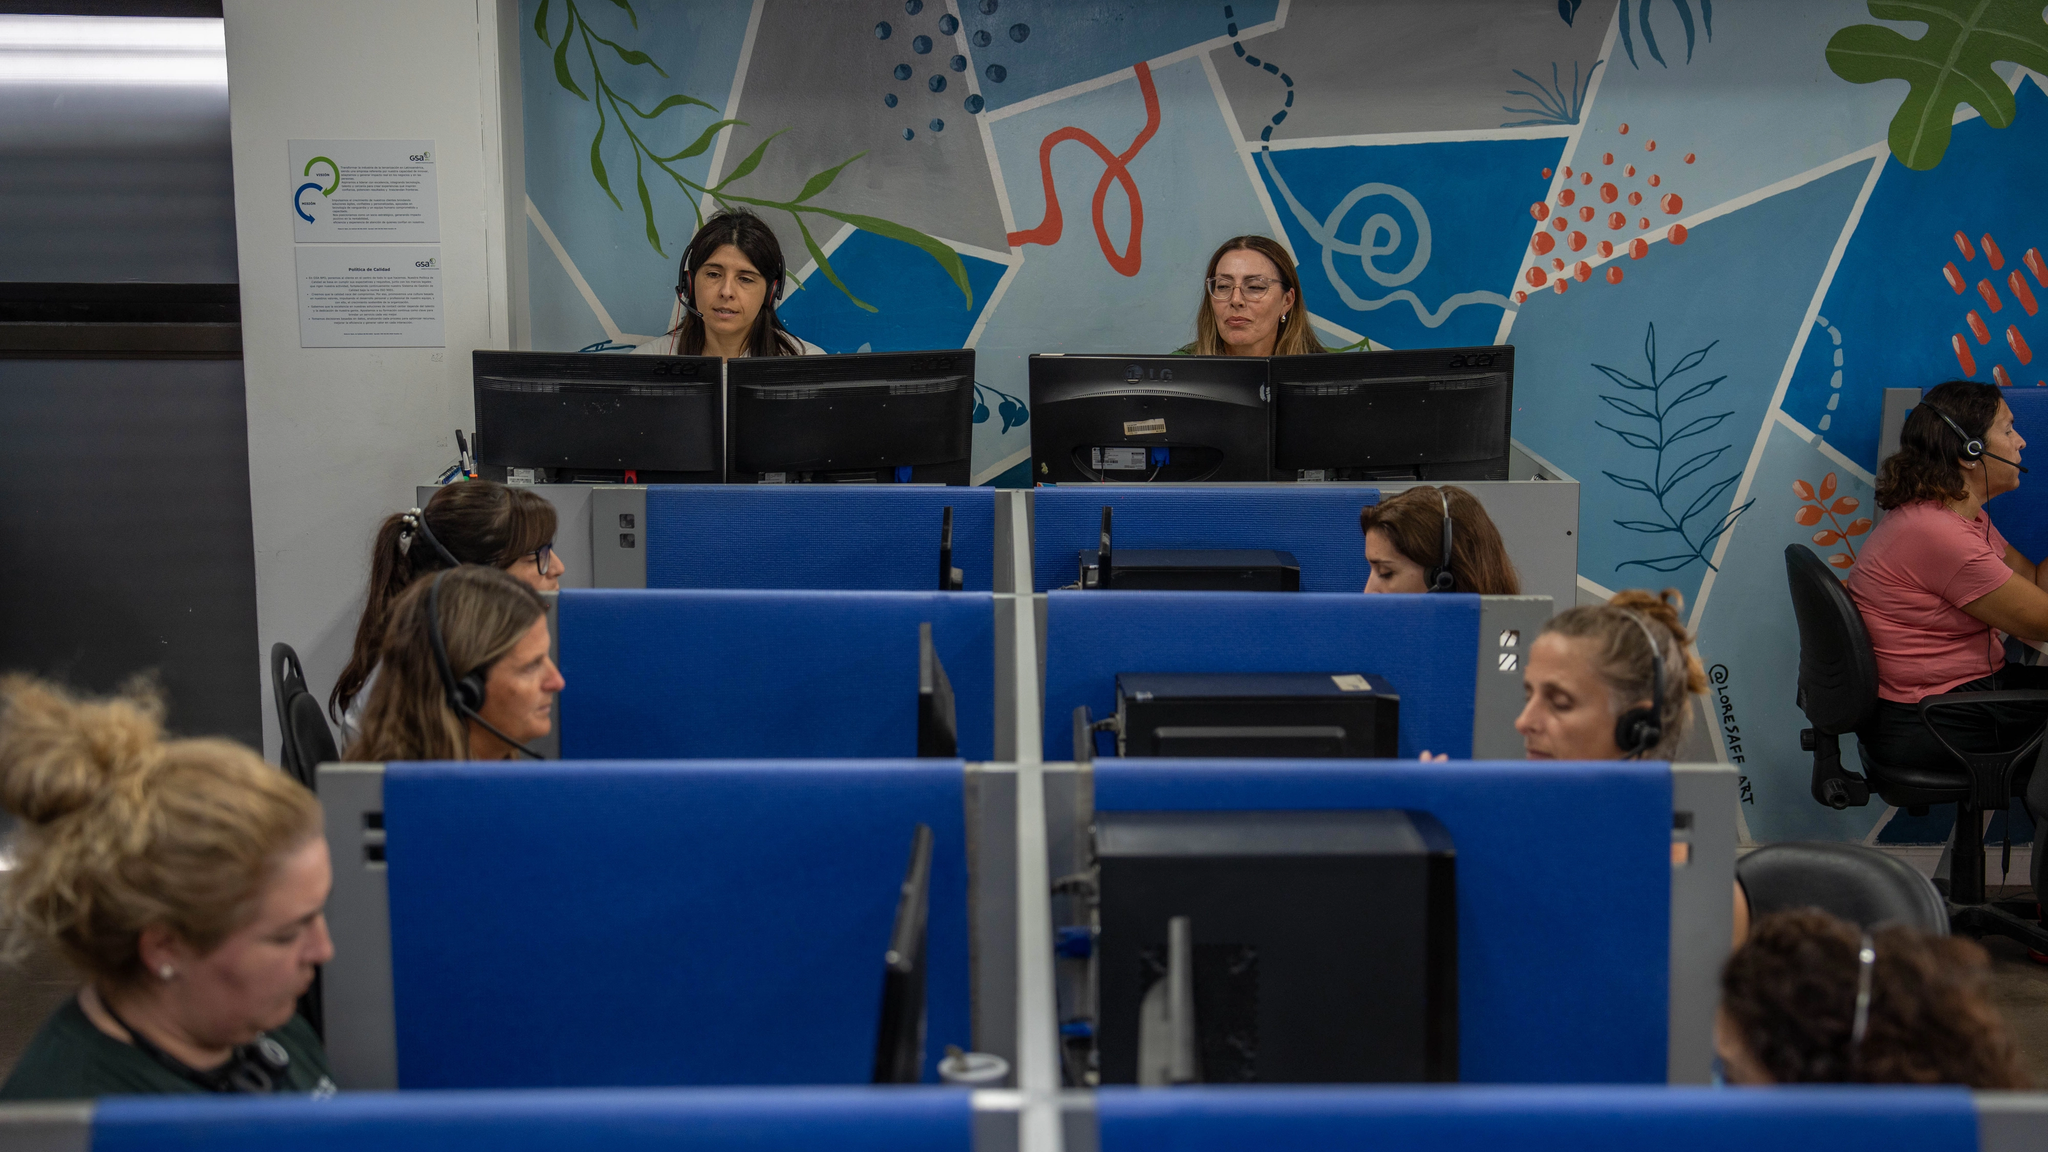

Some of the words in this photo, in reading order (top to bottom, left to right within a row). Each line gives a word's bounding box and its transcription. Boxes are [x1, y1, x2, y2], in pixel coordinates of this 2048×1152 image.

[652, 360, 708, 376] acer
[909, 356, 963, 373] acer
[1449, 352, 1503, 368] acer
[1149, 368, 1173, 383] LG
